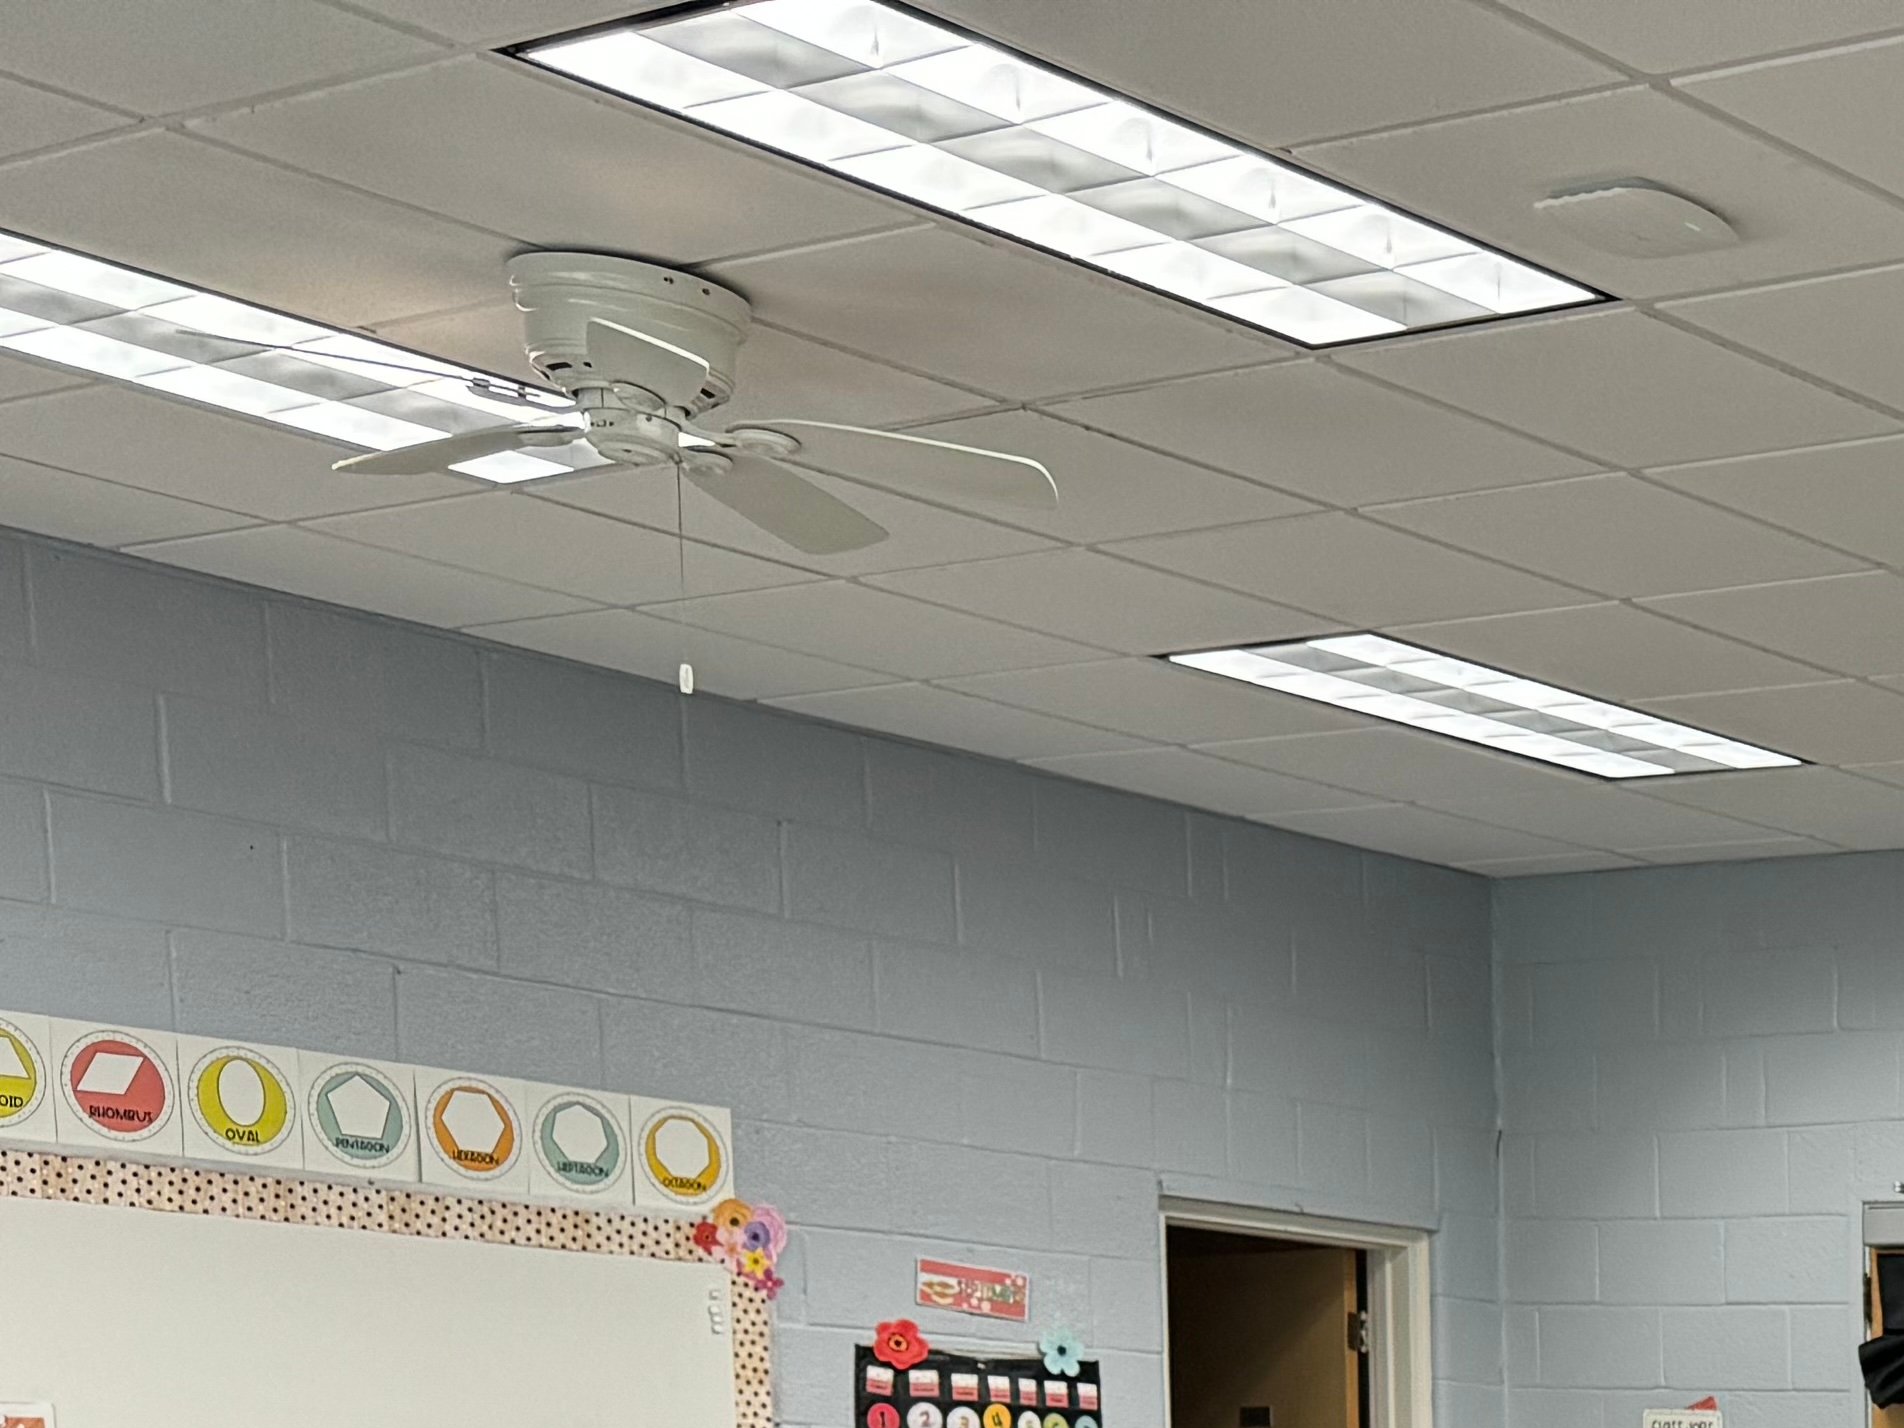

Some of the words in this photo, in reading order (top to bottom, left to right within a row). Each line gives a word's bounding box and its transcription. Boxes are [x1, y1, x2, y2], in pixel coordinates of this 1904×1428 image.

[89, 1104, 153, 1124] RHOMBUS
[225, 1128, 259, 1144] OVAL
[880, 1411, 887, 1428] 1
[919, 1411, 931, 1428] 2
[991, 1411, 1003, 1428] 4
